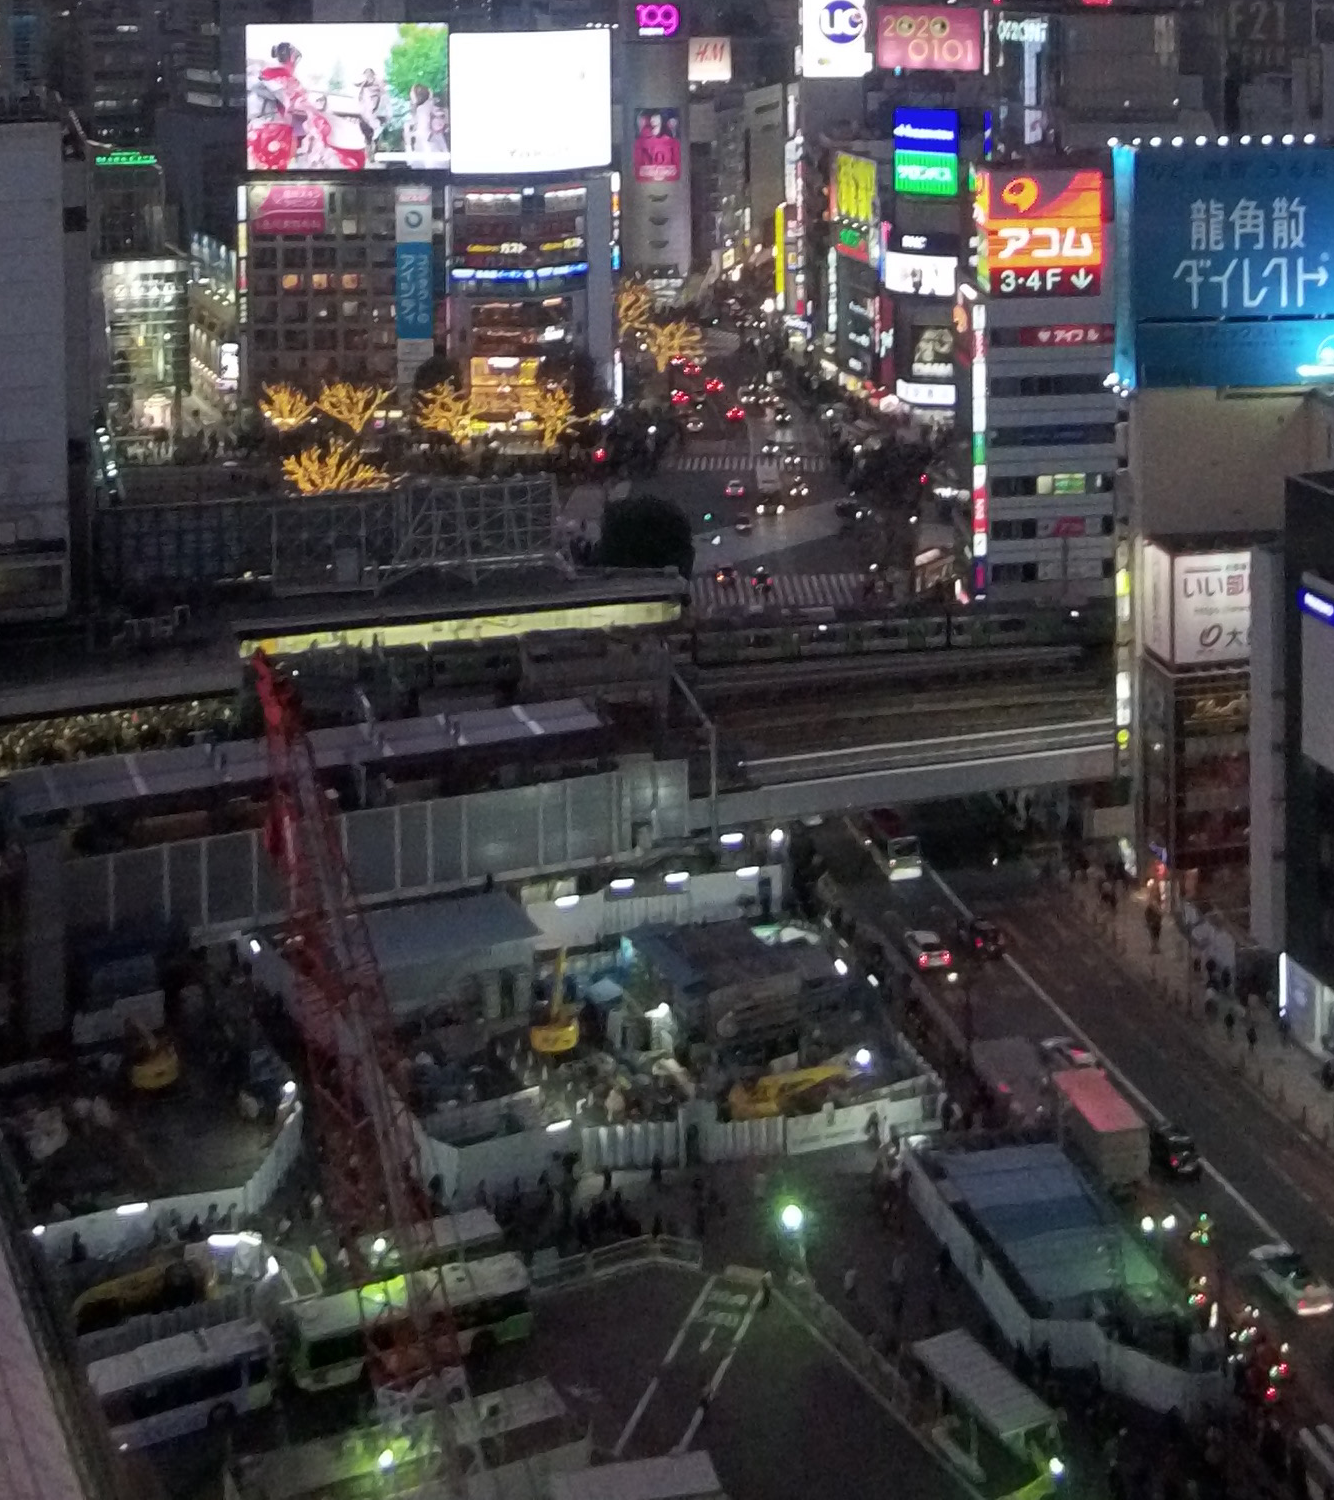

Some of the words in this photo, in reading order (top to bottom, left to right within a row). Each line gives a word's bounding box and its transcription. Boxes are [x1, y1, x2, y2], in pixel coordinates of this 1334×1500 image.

[637, 4, 680, 36] 109
[998, 227, 1094, 260] アコム
[1189, 196, 1307, 251] 龍角散
[1173, 255, 1329, 310] ダイレクト
